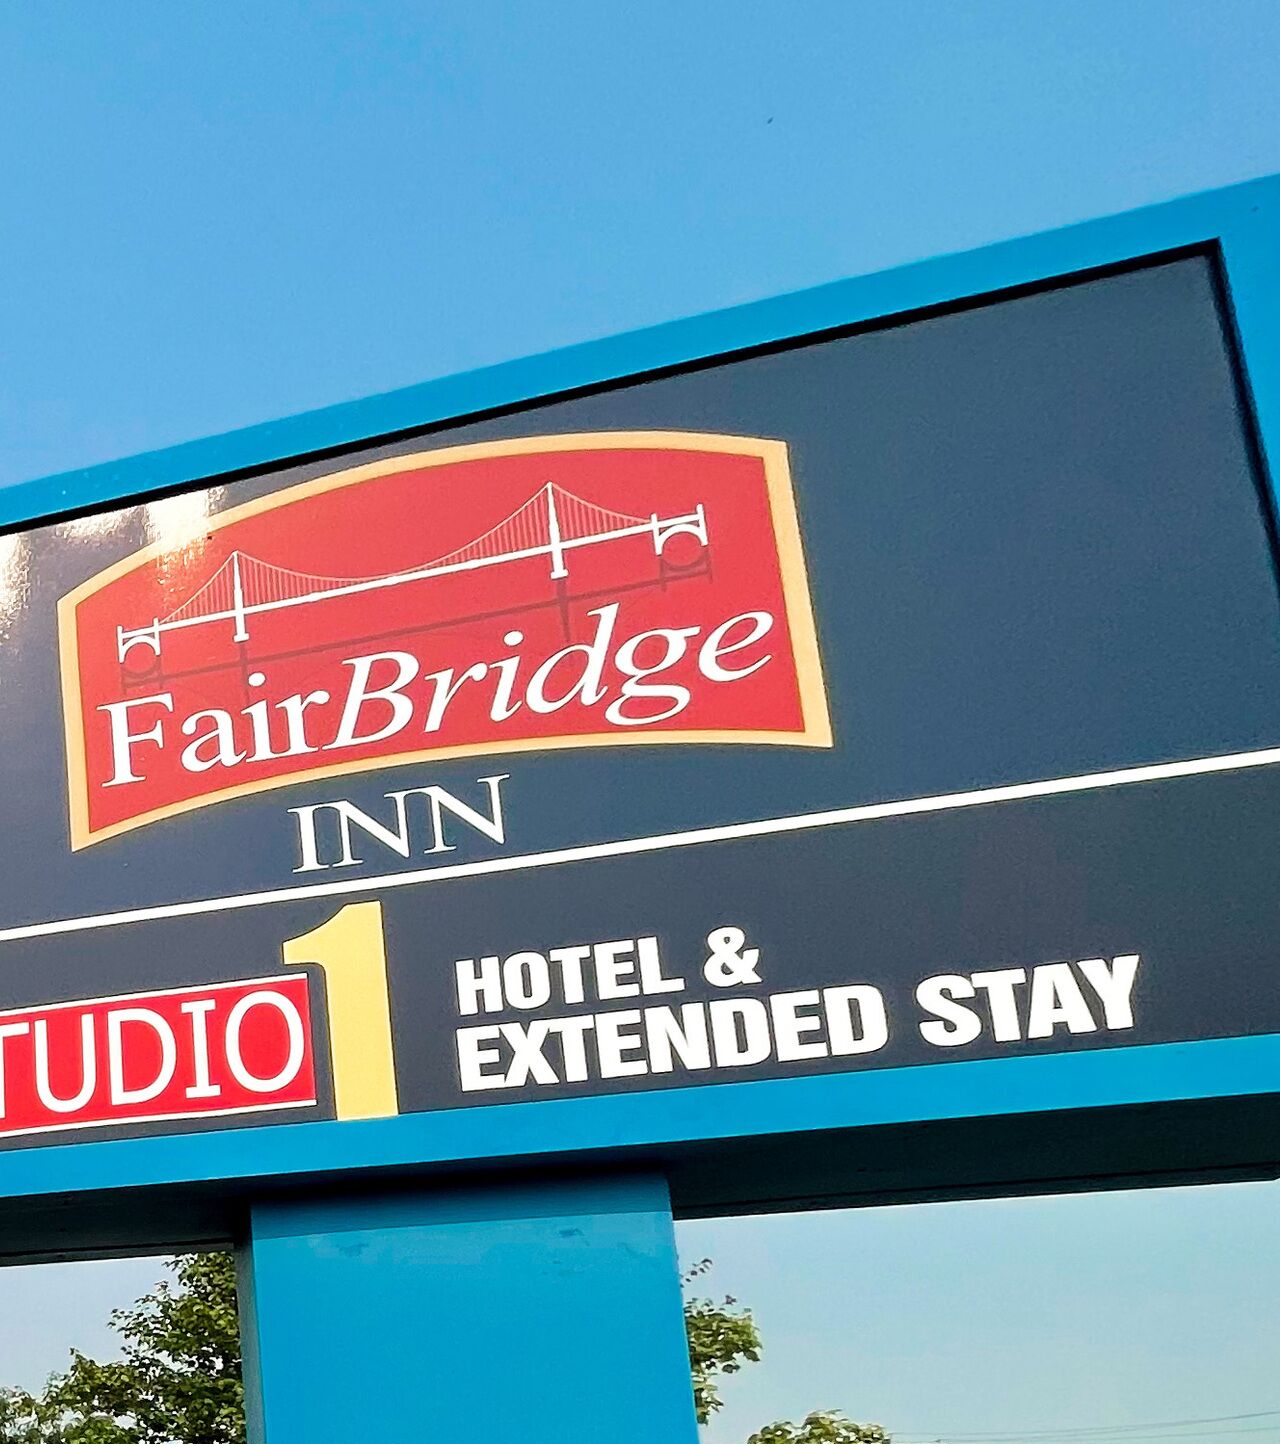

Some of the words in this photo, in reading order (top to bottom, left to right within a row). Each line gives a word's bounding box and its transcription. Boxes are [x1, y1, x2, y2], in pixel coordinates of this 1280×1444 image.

[96, 602, 775, 787] FairBridge
[288, 774, 510, 873] INN
[282, 901, 399, 1121] 1
[455, 936, 684, 1014] HOTEL
[702, 926, 763, 986] &
[456, 984, 890, 1092] EXTENDED
[917, 955, 1142, 1048] STAY
